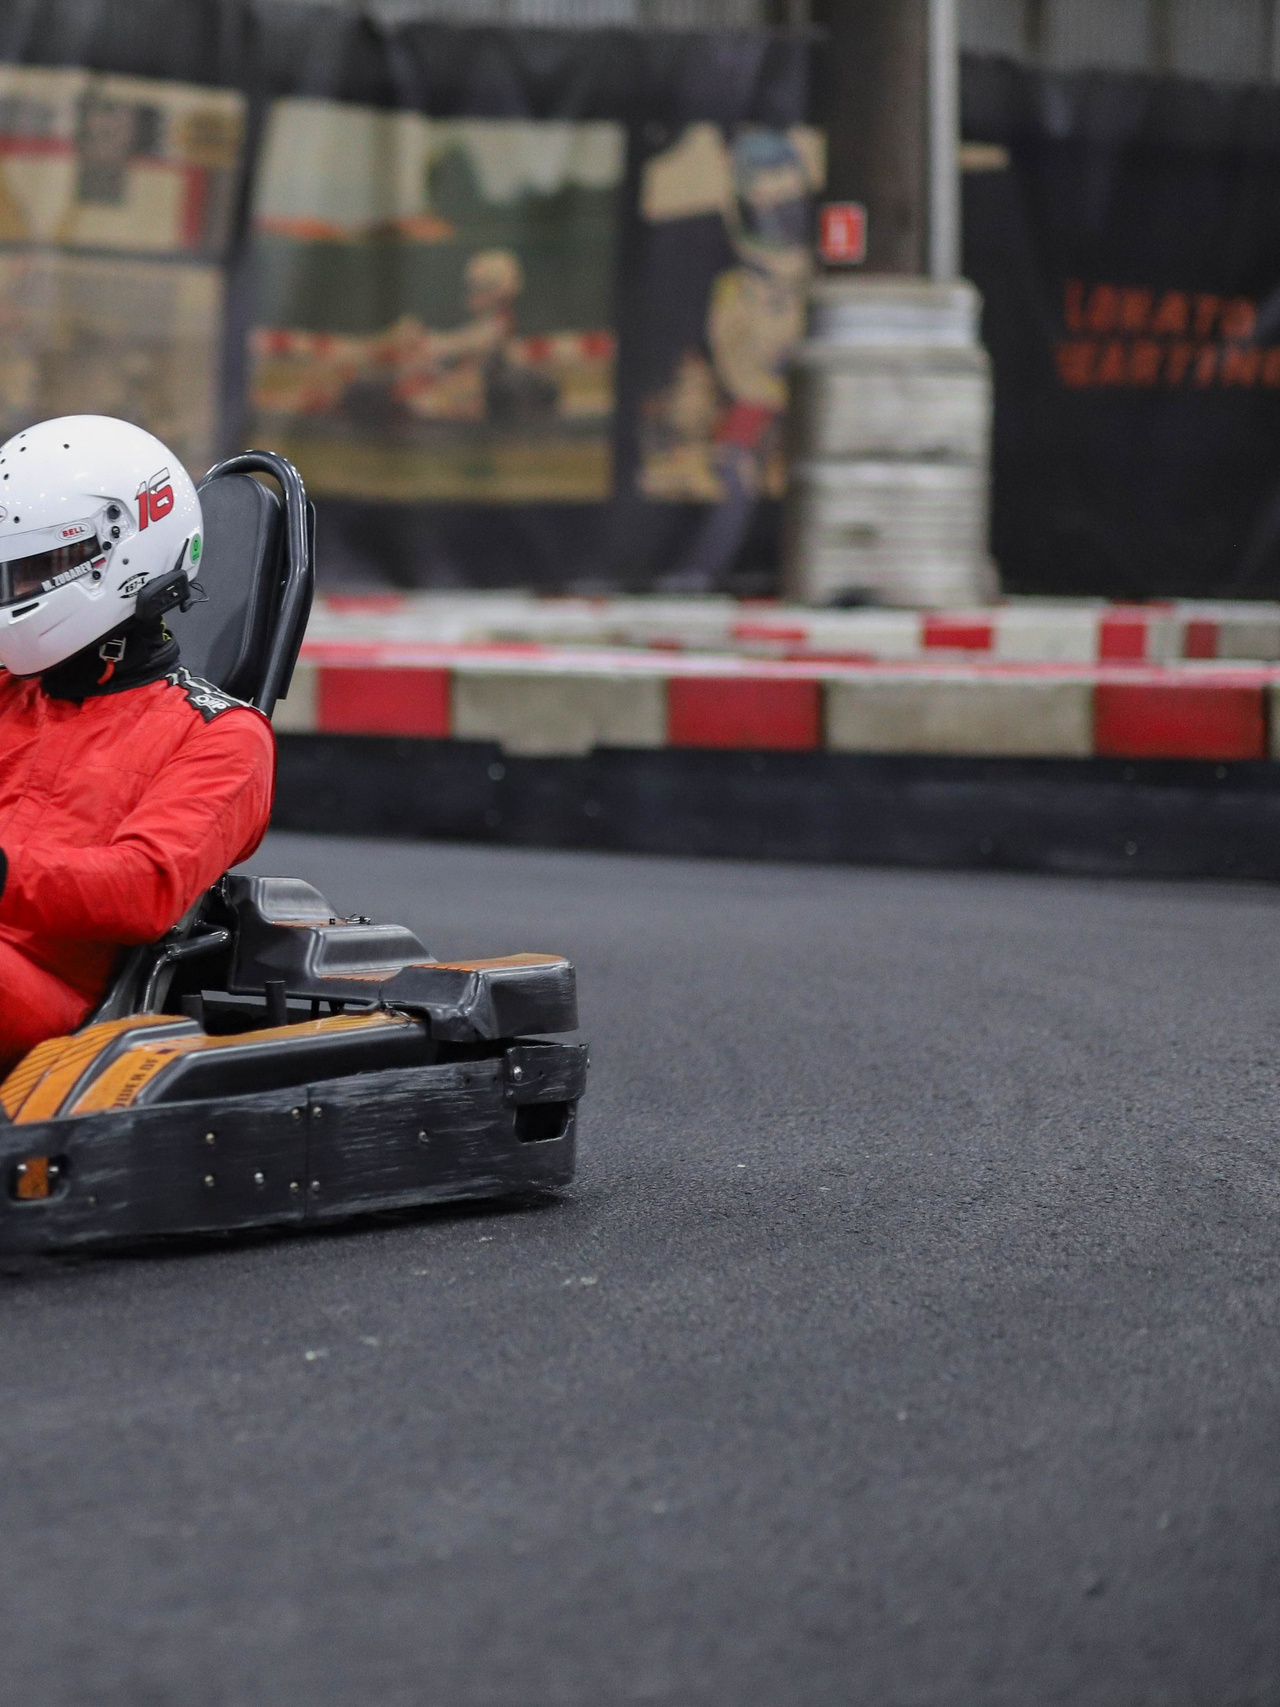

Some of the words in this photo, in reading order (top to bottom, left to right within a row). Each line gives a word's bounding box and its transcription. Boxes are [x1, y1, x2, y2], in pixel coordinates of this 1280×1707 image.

[134, 466, 174, 532] 16
[62, 526, 86, 537] BELL
[52, 560, 93, 586] ZUBAREV
[195, 694, 228, 710] OMP
